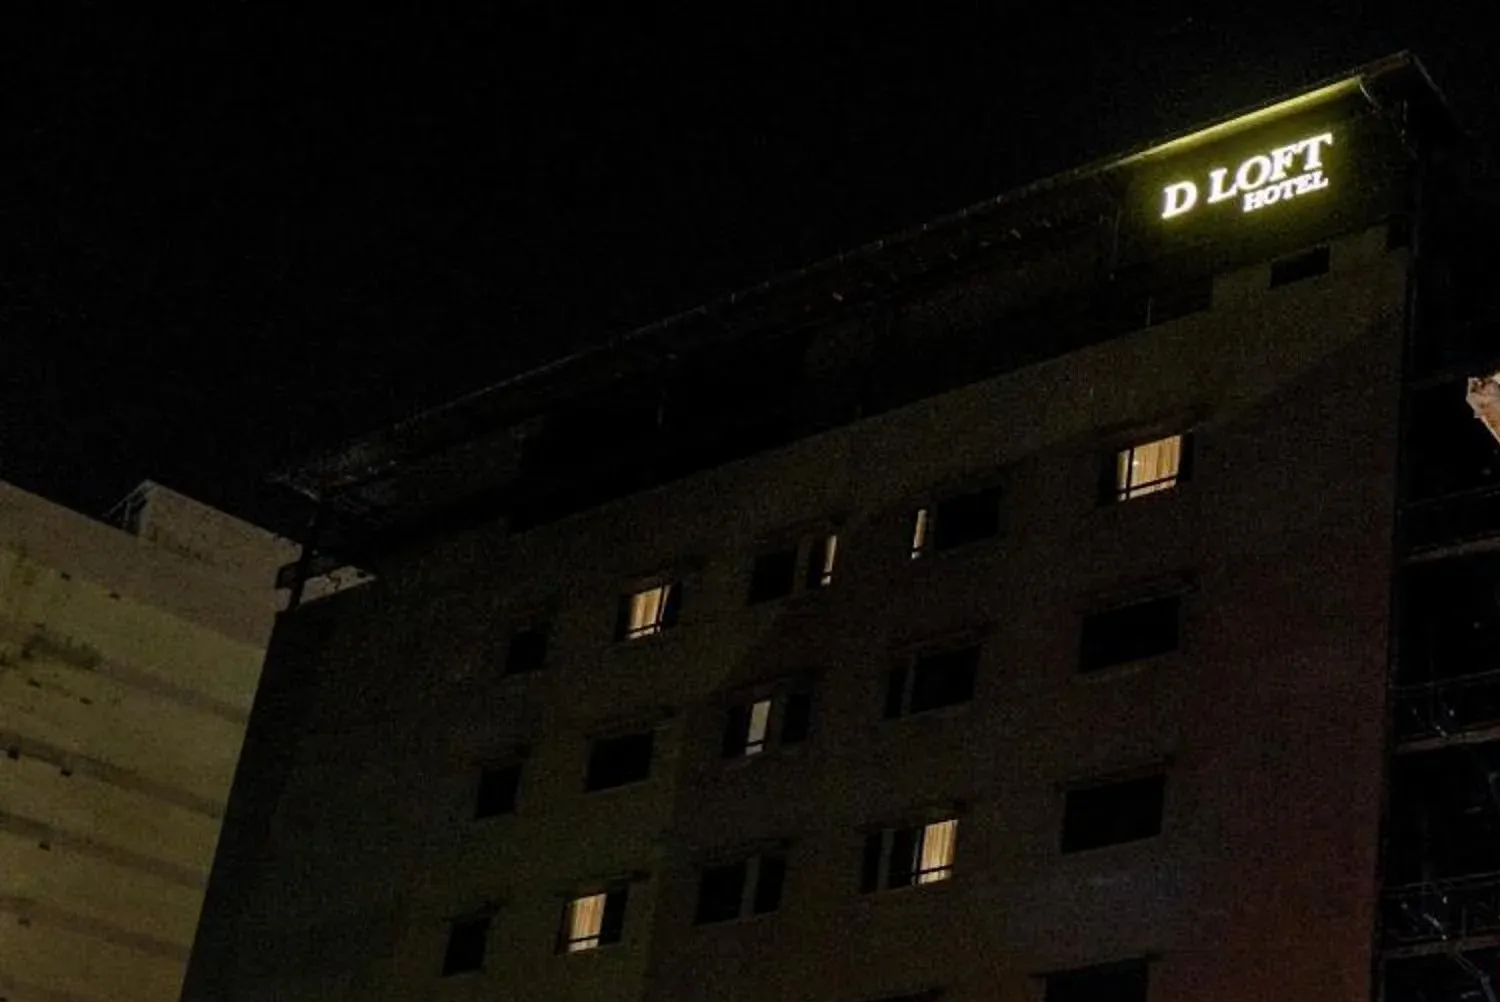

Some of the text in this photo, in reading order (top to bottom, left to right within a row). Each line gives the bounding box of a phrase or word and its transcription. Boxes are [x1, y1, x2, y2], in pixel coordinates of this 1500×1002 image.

[1161, 132, 1333, 219] D LOFT
[1243, 170, 1328, 212] HOTEL
